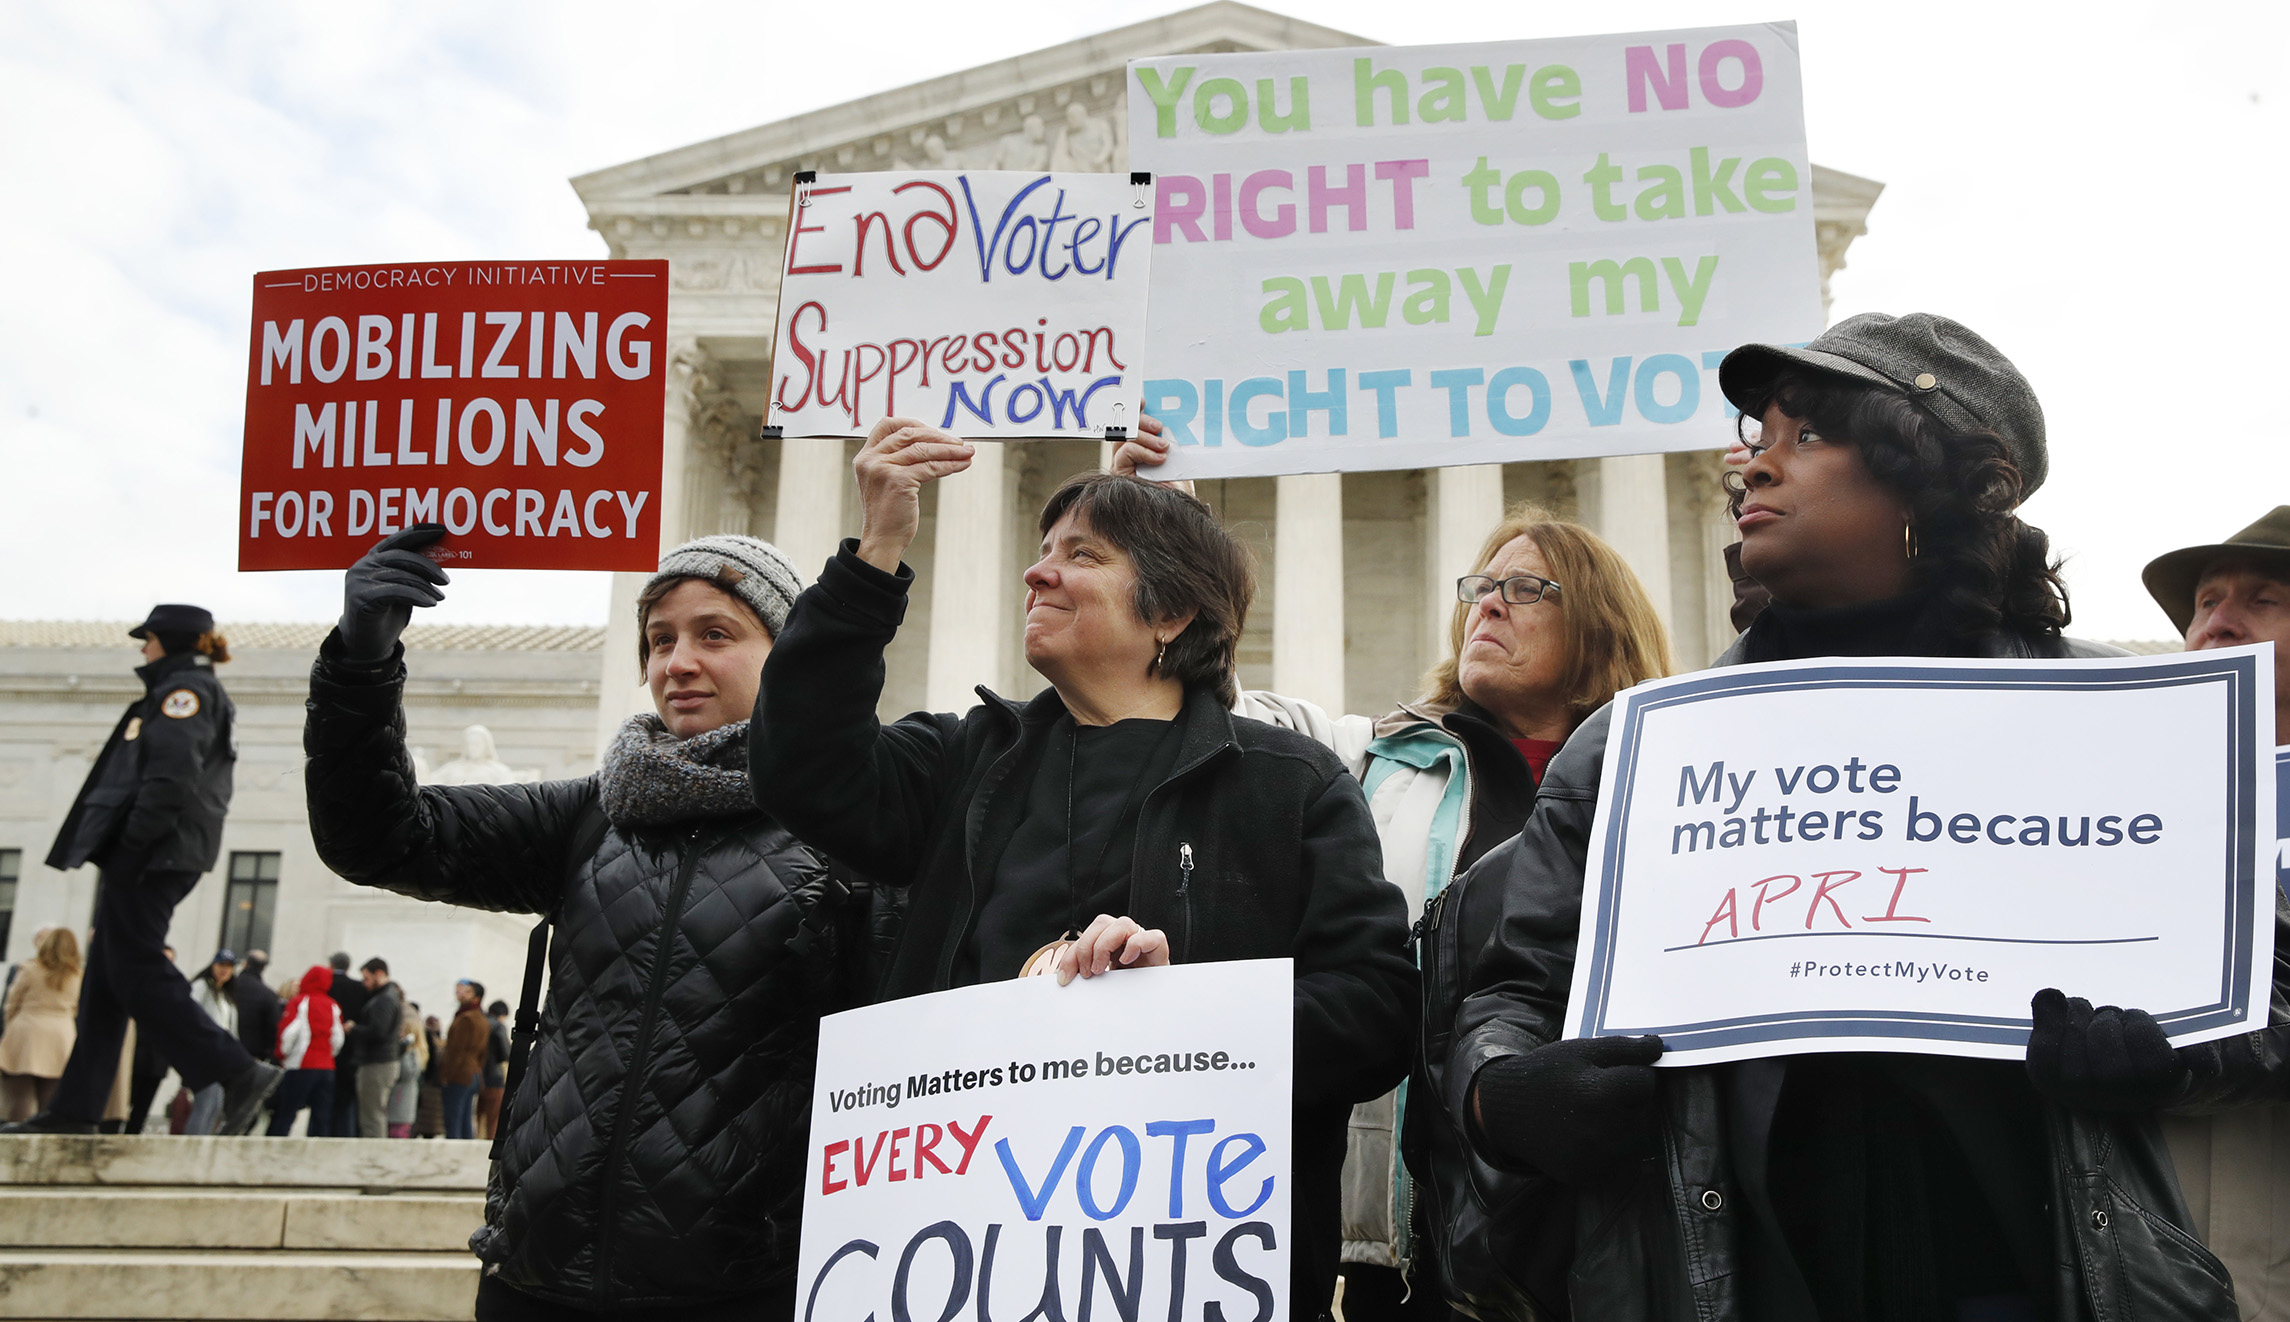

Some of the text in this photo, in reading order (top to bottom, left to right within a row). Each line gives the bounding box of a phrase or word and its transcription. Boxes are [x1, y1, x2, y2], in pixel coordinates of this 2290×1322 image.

[1136, 40, 1763, 137] You have NO
[787, 176, 1149, 282] End Voter
[1154, 146, 1798, 244] RIGHT to take
[304, 265, 606, 293] DEMOCRACY INITIATIVE
[1260, 256, 1719, 336] away my
[261, 312, 651, 385] MOBILIZING
[779, 302, 1124, 427] Suppression
[942, 375, 1120, 428] NOW
[1144, 341, 1811, 447] RIGHT TO VO
[293, 397, 605, 469] MILLIONS
[251, 487, 649, 538] FOR DEMOCRACY
[459, 551, 472, 559] 101
[1677, 757, 1901, 814] My vote
[1672, 796, 2162, 854] matters because
[1699, 867, 1930, 944] APRI
[1791, 962, 1988, 982] #ProtectMyVote
[830, 1052, 1255, 1112] Voting Matters to me because...
[823, 1115, 992, 1195] EVERY
[804, 1219, 1277, 1322] COUNTS
